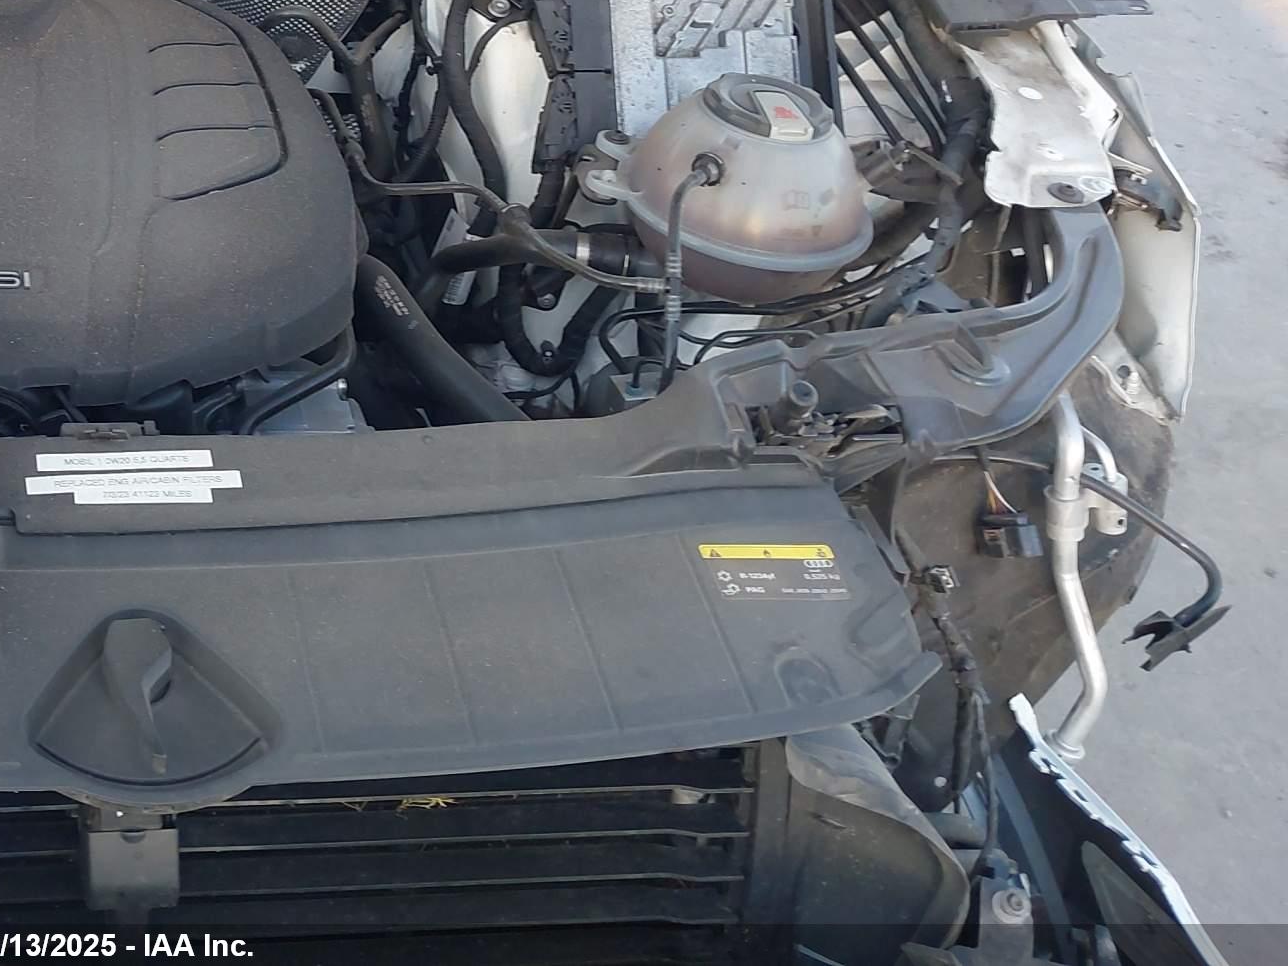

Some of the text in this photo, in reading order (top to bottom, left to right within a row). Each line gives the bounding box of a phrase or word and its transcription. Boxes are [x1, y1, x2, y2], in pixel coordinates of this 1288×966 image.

[149, 454, 190, 463] QUARTS
[54, 478, 105, 488] REPLACED
[107, 477, 129, 486] ENG
[182, 474, 223, 484] FILTERS
[162, 490, 192, 498] MILES
